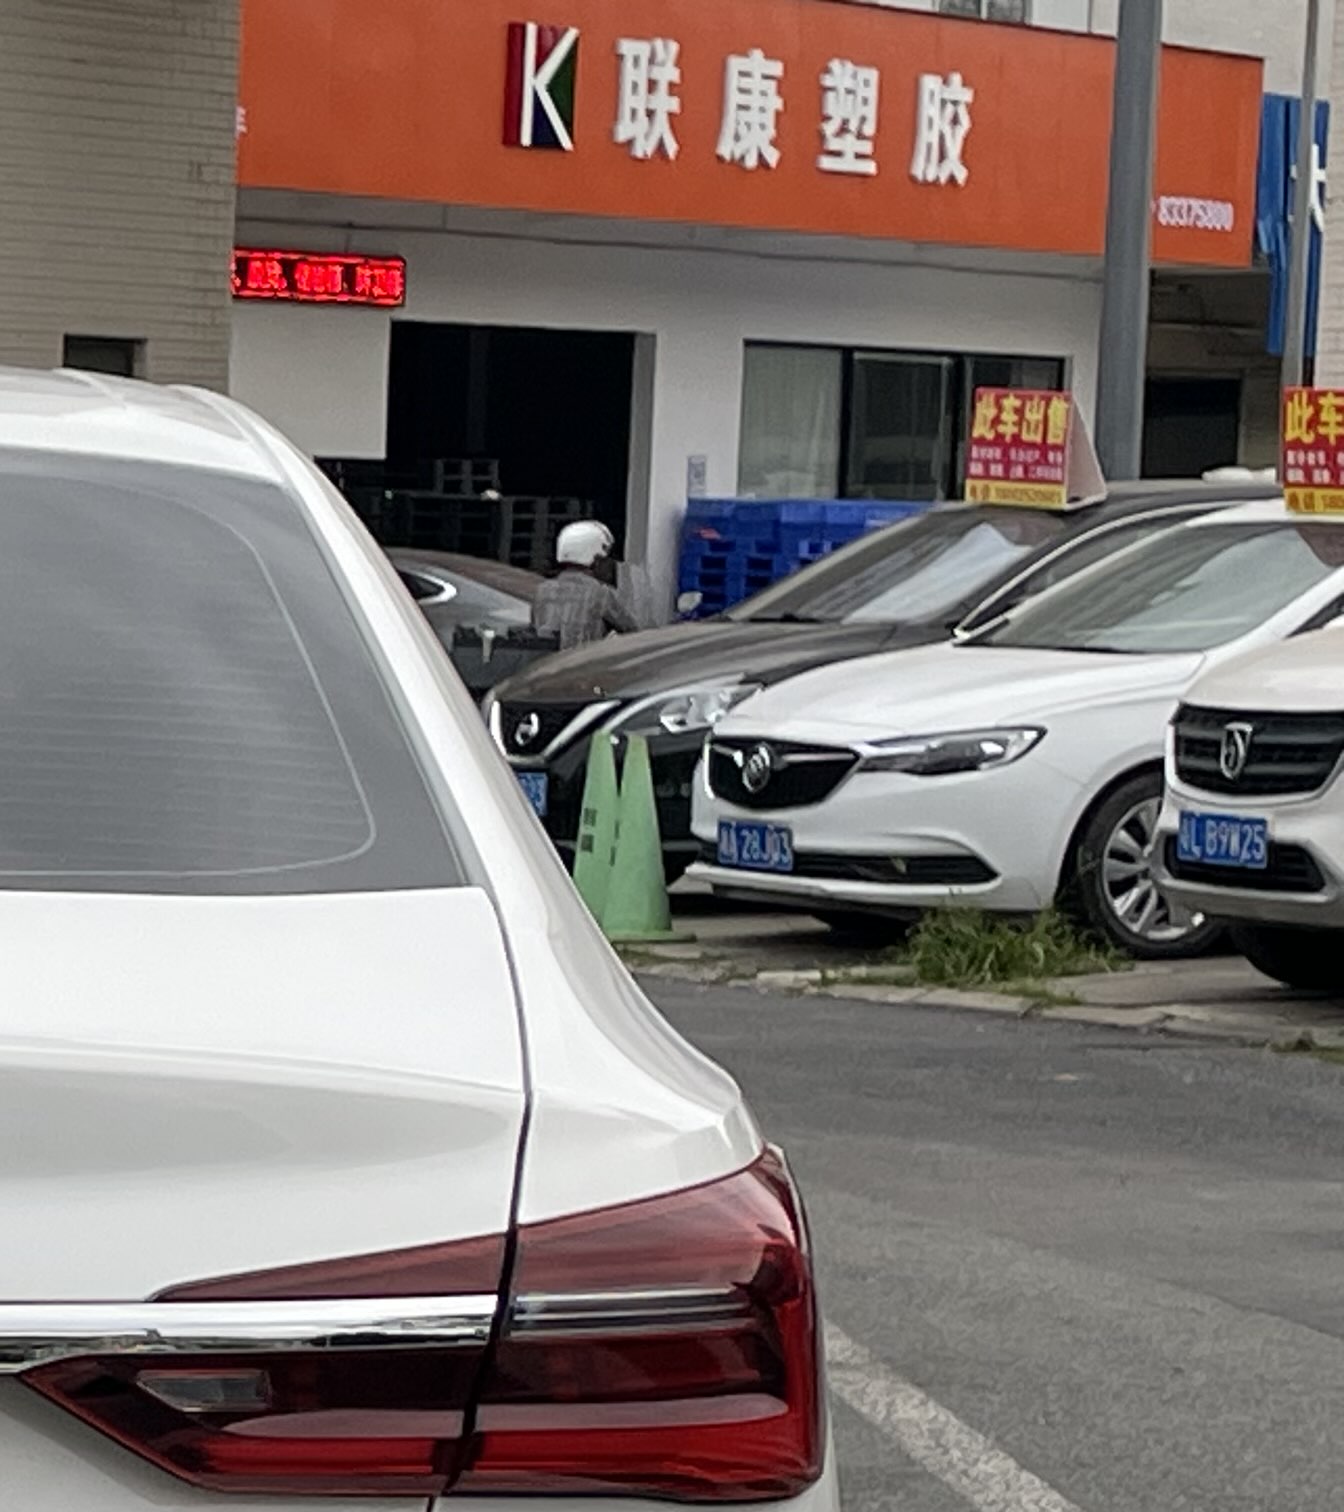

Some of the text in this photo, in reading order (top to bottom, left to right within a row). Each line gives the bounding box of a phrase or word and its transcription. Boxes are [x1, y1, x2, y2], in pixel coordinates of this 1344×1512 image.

[614, 37, 974, 186] 联康塑胶
[972, 392, 1069, 445] 此车出售
